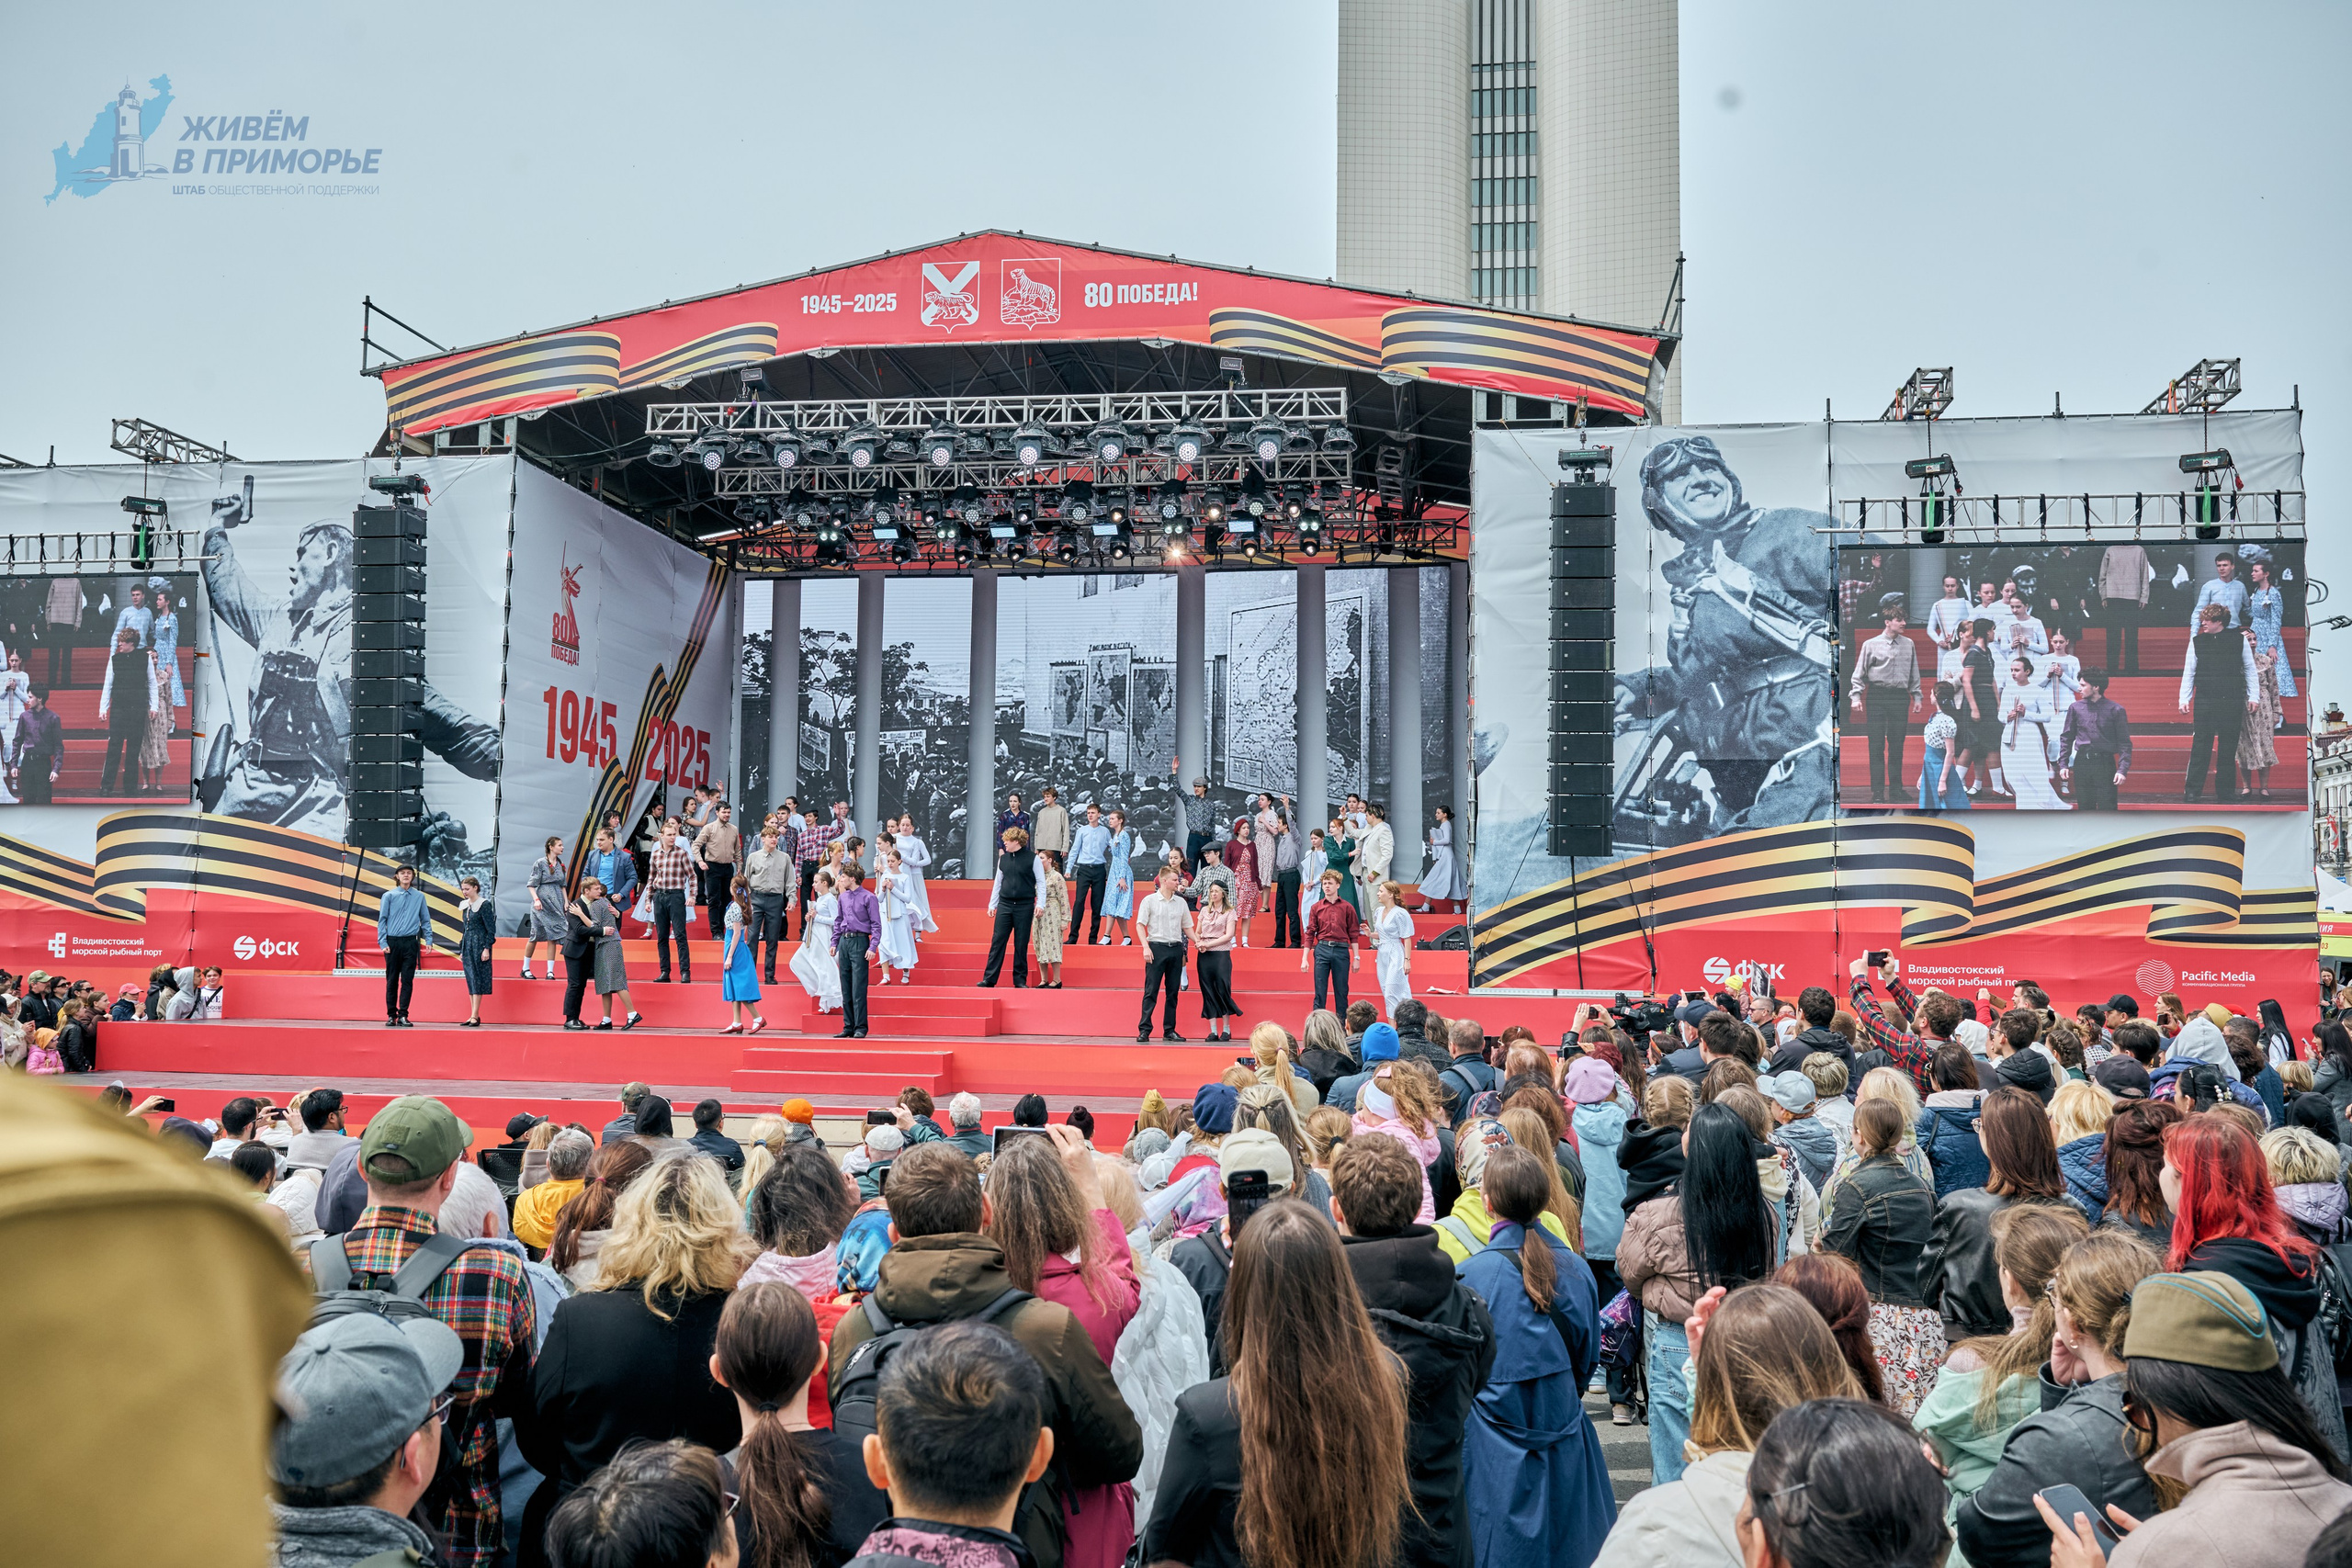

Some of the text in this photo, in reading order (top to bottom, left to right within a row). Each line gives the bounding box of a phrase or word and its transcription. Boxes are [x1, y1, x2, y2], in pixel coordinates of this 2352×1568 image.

[1084, 281, 1198, 308] 80 ПОБЕДА!
[552, 612, 569, 642] 80
[551, 644, 580, 667] ПОБЕДА!
[543, 685, 617, 770] 1945
[645, 716, 711, 790] 2025
[73, 936, 144, 947] Владивостокский
[72, 947, 164, 958] морской рыбный порт
[1908, 964, 2005, 975] Владивостокский
[2181, 970, 2256, 982] Pacific Media
[1908, 976, 1955, 987] морской
[1958, 976, 2003, 987] рыбный
